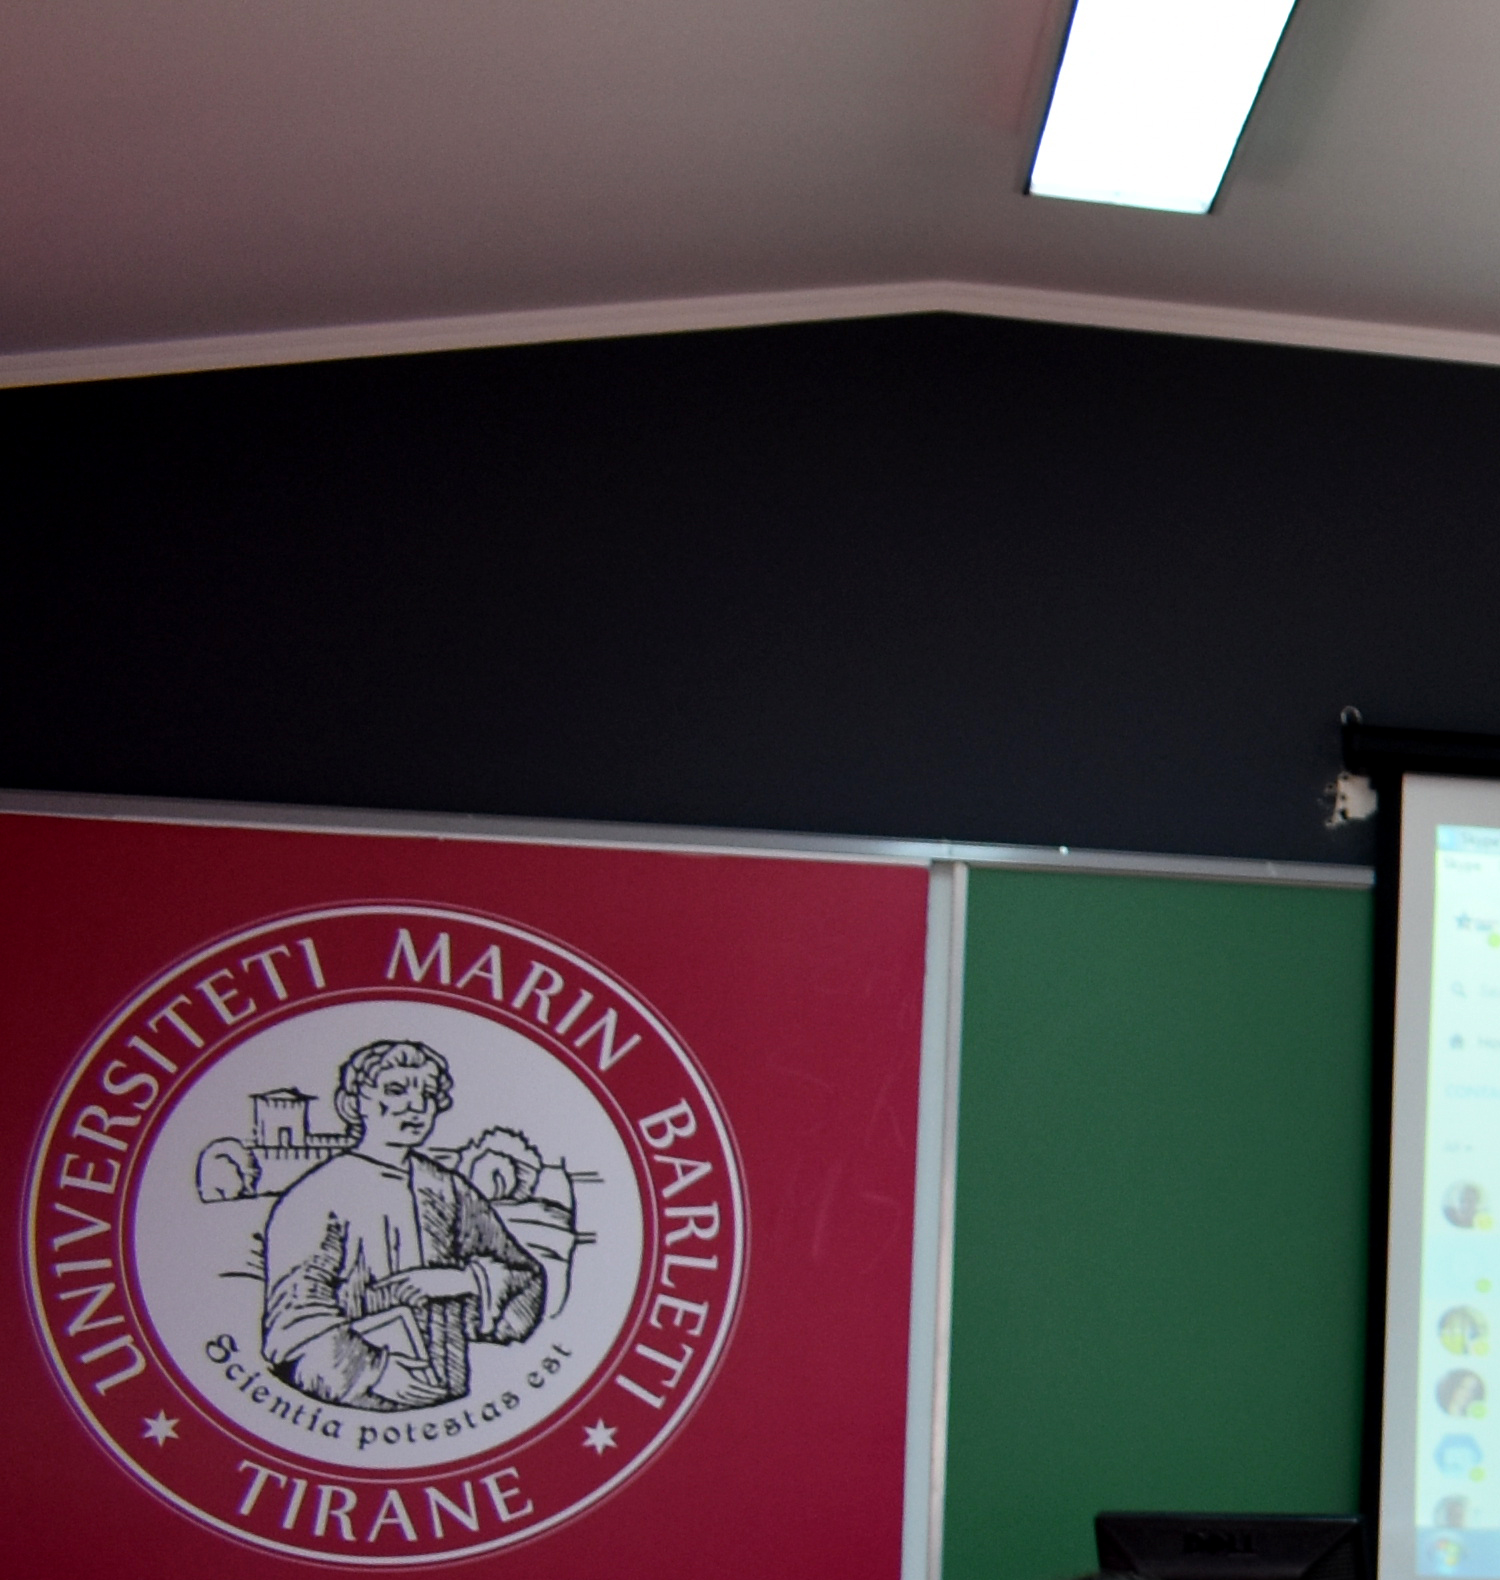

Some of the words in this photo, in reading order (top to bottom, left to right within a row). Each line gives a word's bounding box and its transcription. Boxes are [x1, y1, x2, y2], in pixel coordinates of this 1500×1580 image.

[55, 936, 327, 1397] UNIVERSITETI
[387, 928, 643, 1072] MARIN
[616, 1098, 721, 1411] BARLETI
[205, 1333, 342, 1440] Scientia
[358, 1390, 521, 1451] potestas
[527, 1341, 573, 1389] est
[237, 1459, 535, 1544] TIRANE
